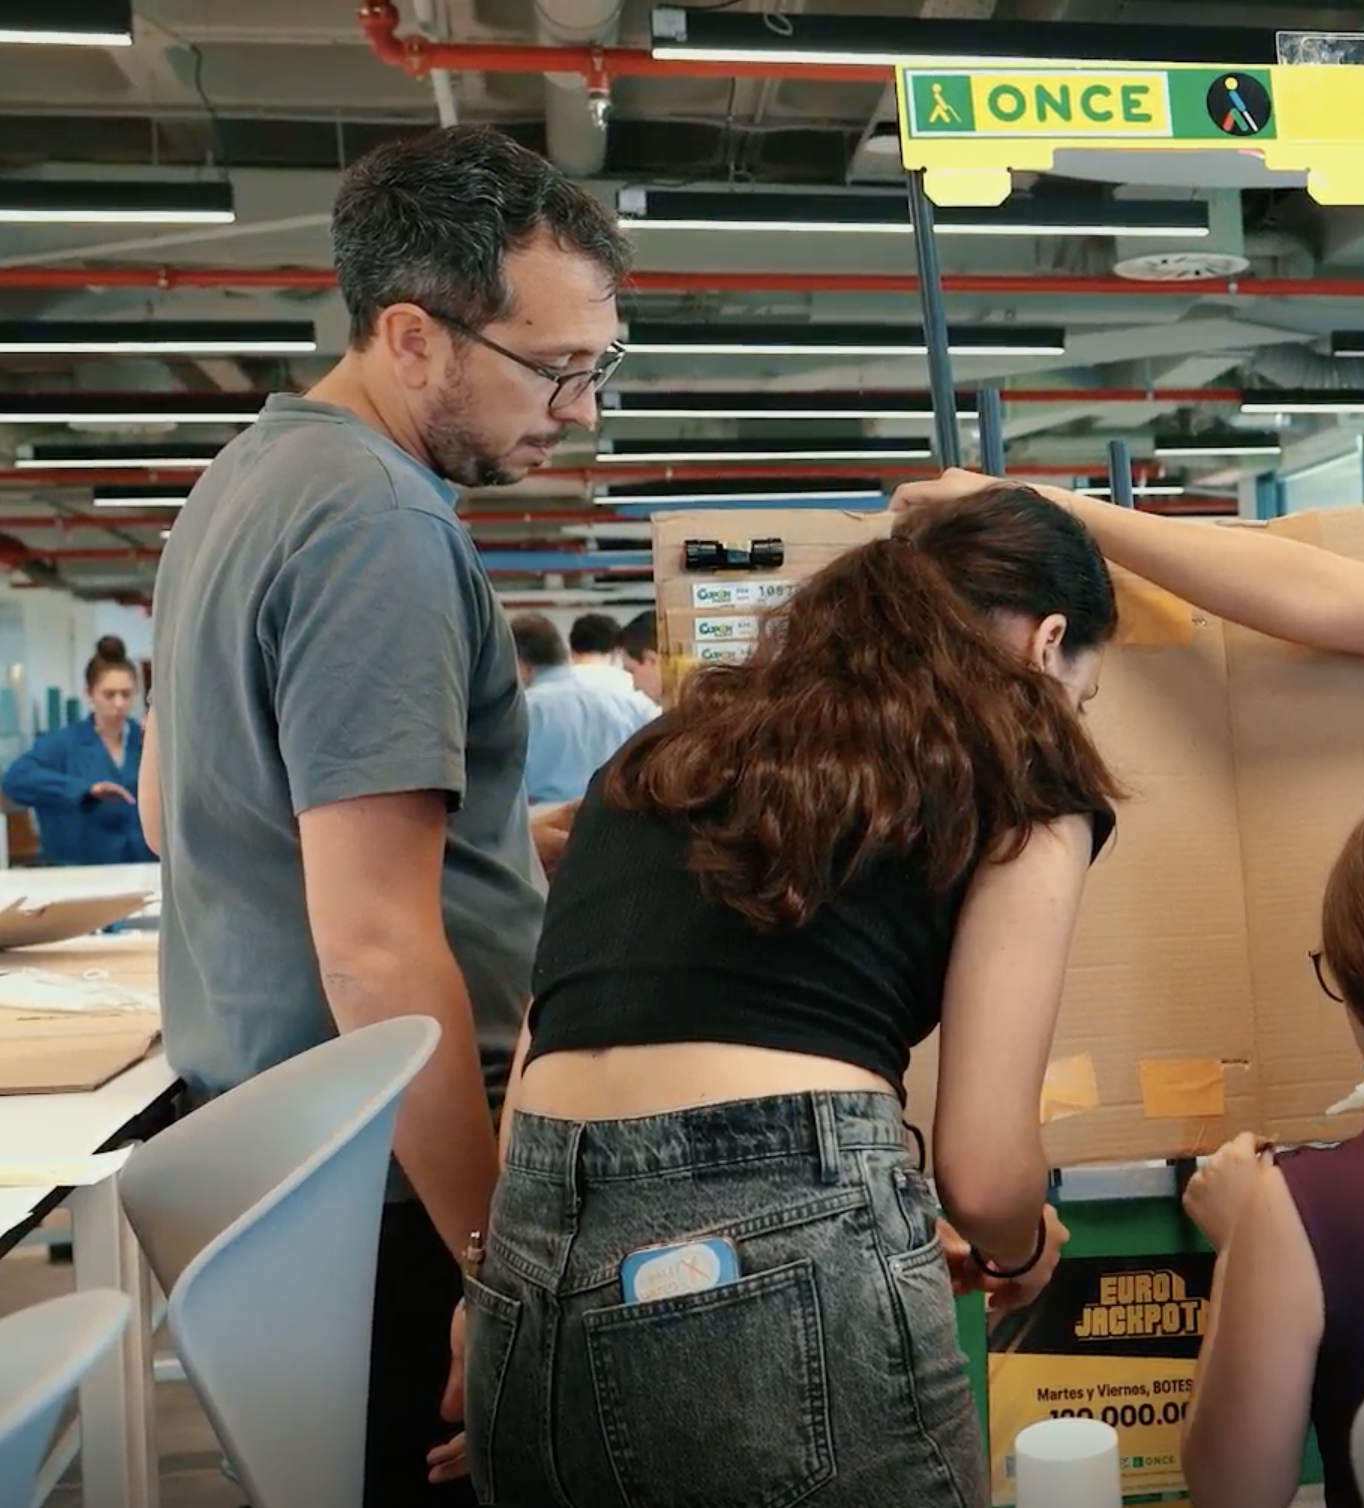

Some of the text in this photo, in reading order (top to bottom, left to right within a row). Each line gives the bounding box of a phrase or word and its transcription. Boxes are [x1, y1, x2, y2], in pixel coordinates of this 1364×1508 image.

[986, 83, 1153, 123] ONCE
[1099, 1272, 1174, 1305] EURO
[1074, 1302, 1200, 1339] JACKPOT
[1037, 1379, 1193, 1401] Martes y Viernes, BOTES
[1145, 1455, 1174, 1466] ONCE
